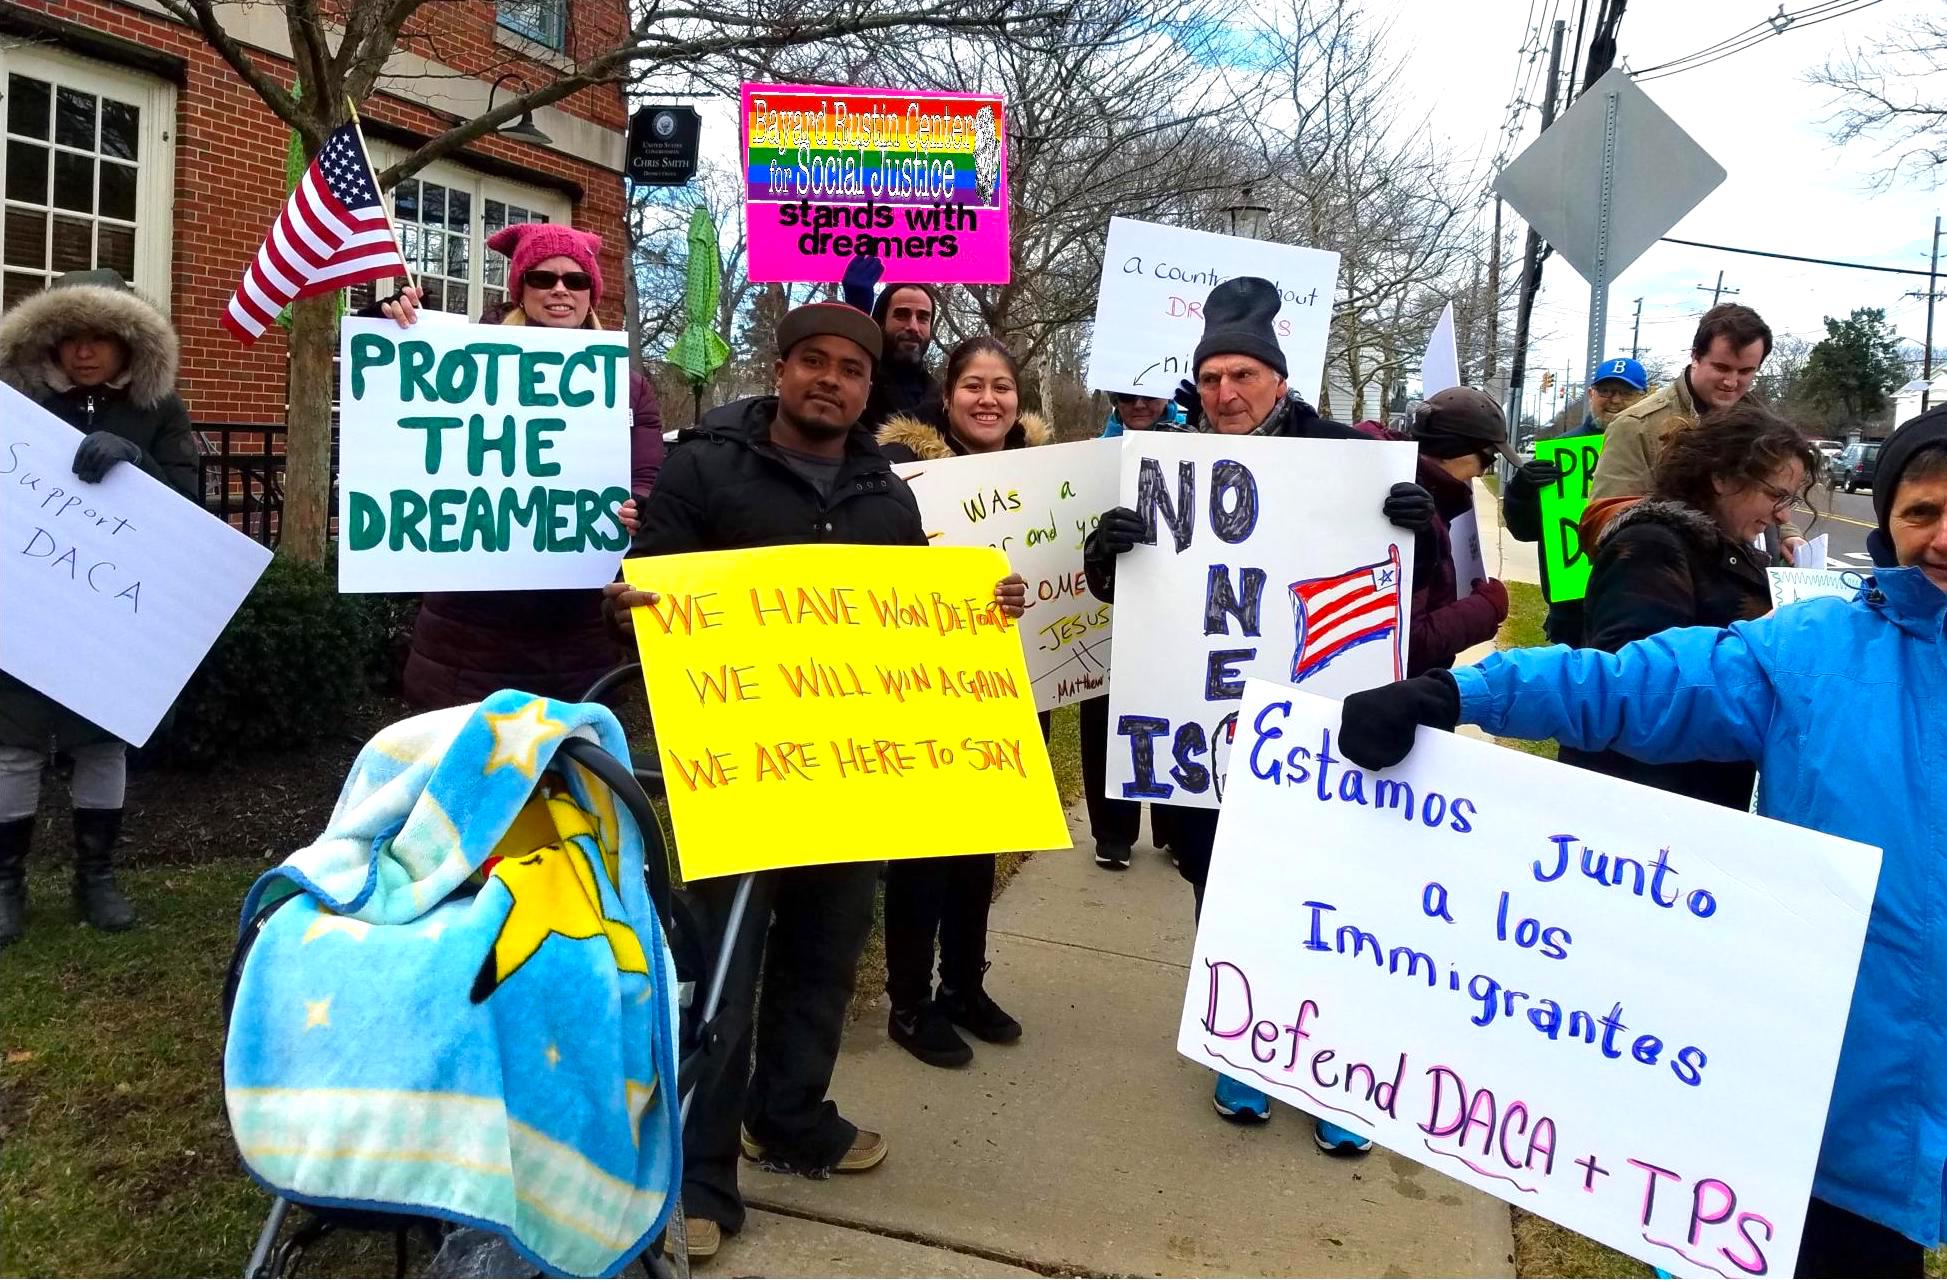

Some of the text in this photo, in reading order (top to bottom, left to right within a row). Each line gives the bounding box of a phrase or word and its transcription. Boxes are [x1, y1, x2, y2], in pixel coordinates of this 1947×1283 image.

[752, 98, 975, 156] Bayard Rustin Center
[633, 156, 689, 168] CHRIS SMITH
[768, 140, 955, 199] for Social Justice
[778, 199, 978, 232] stands with
[797, 222, 959, 259] dreamers
[1123, 256, 1144, 275] a
[1154, 262, 1229, 289] countr
[350, 333, 630, 409] PROTECT
[1611, 360, 1627, 375] B
[396, 413, 567, 478] THE
[0, 442, 137, 535] Support
[348, 485, 631, 553] DREAMERS
[1060, 480, 1076, 500] a
[1136, 456, 1260, 555] NO
[1026, 508, 1058, 546] and
[22, 526, 142, 614] DACA
[647, 585, 1016, 637] WE HAVE WON BEFORE
[686, 657, 1020, 708] WE WILL WIN AGAIN
[669, 747, 739, 792] WE
[755, 741, 821, 783] ARE
[830, 736, 917, 779] HERE
[960, 736, 1029, 779] STAY
[1117, 714, 1211, 800] IS
[1249, 700, 1478, 835] Estamos
[1532, 833, 1719, 919] Junto
[1421, 880, 1573, 961] a los
[1301, 900, 1709, 1087] Immigrantes
[1200, 956, 1406, 1121] Defend
[1417, 1064, 1558, 1177] DACA
[1626, 1155, 1774, 1277] TPS
